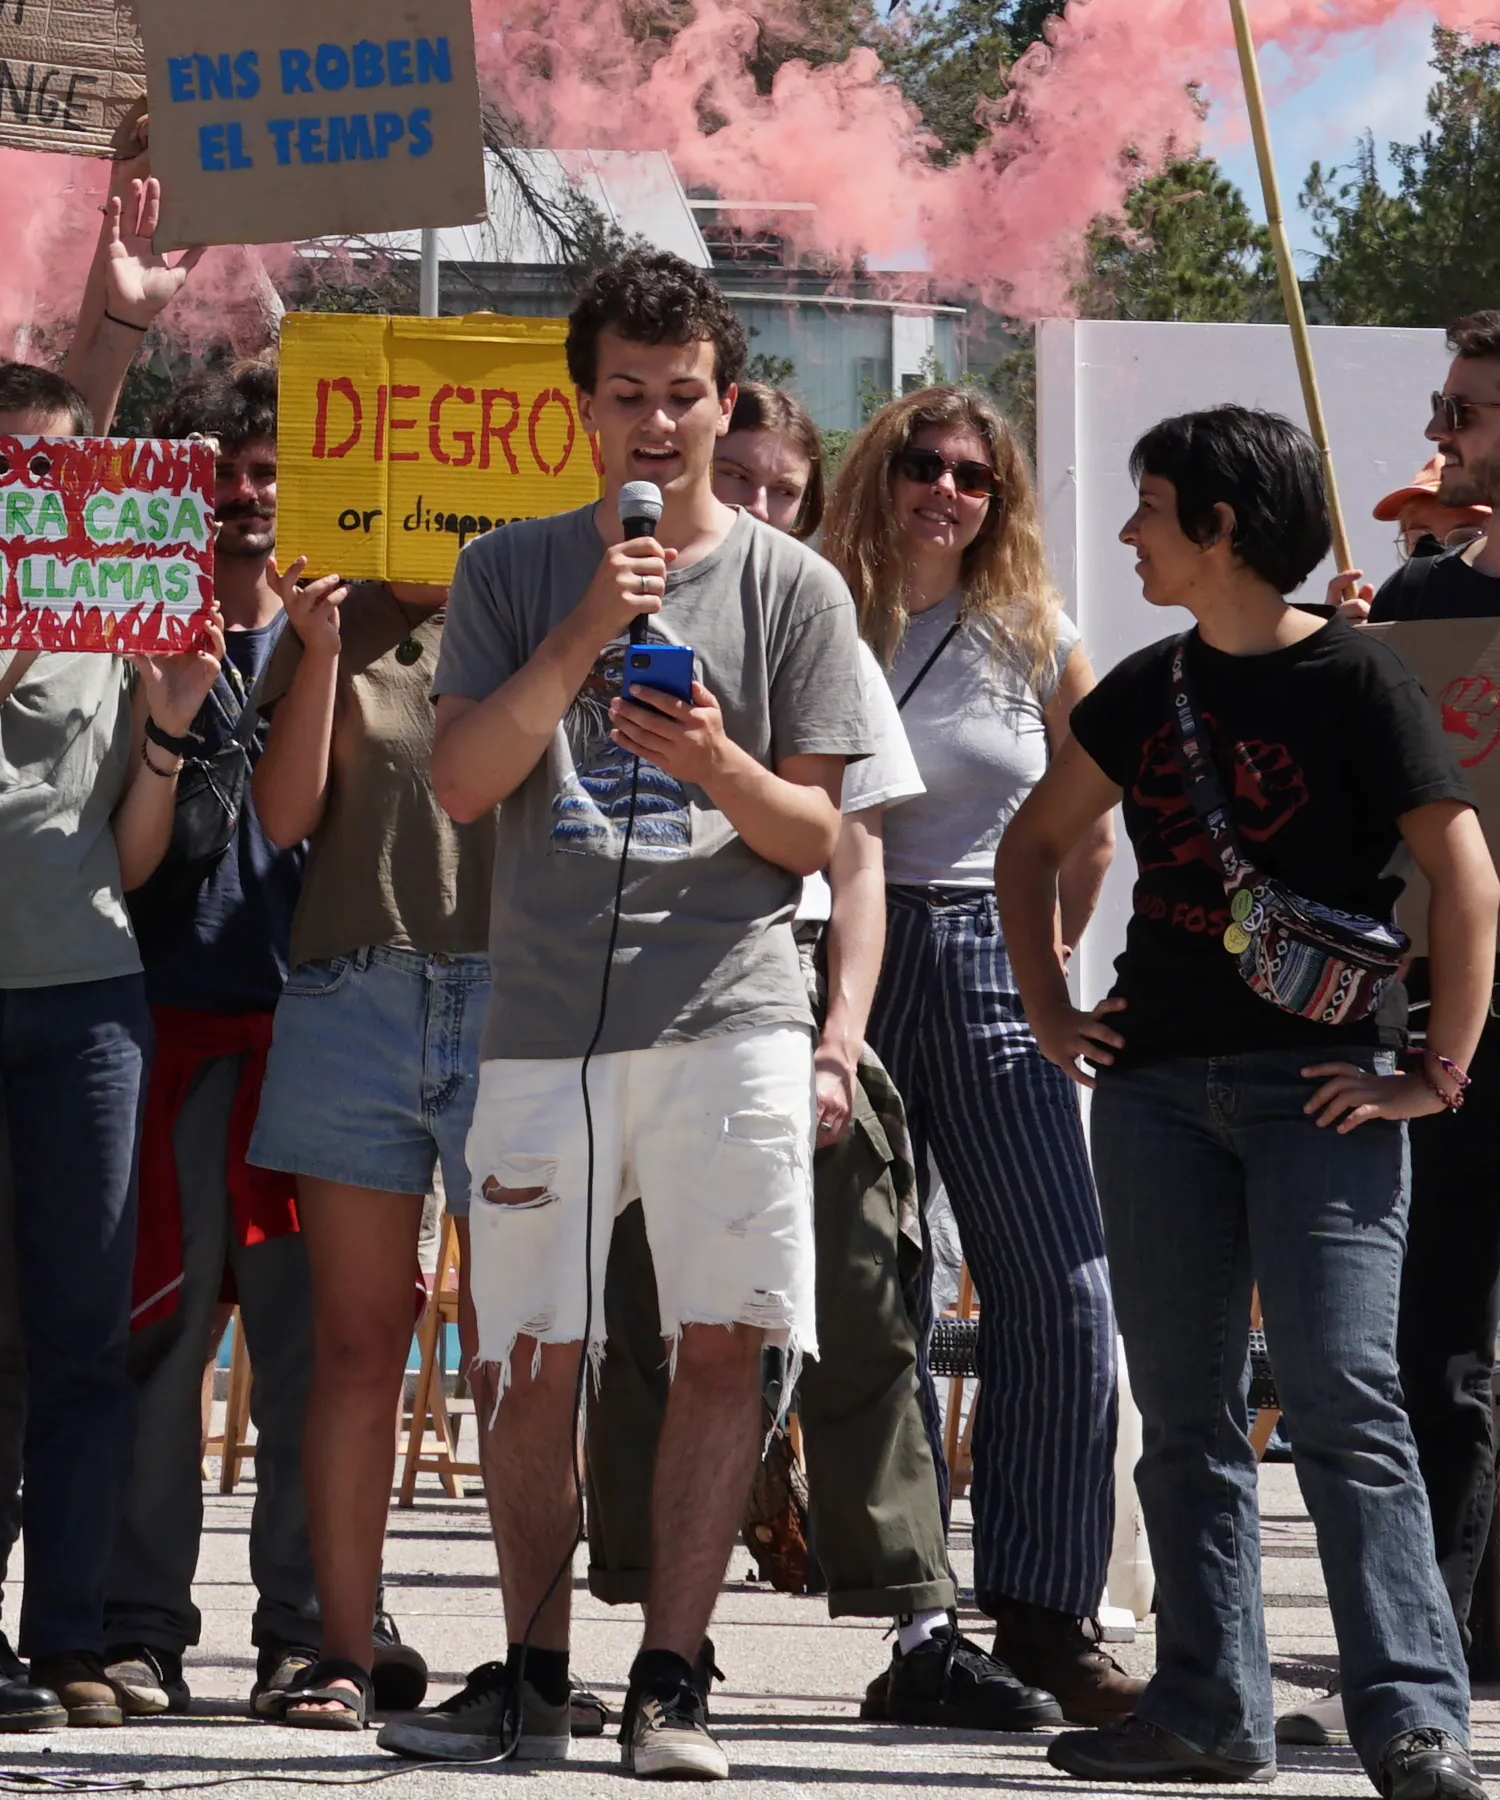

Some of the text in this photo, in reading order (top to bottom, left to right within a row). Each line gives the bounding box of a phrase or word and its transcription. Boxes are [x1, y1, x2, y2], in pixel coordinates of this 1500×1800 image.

[168, 36, 452, 103] ENS ROBEN
[199, 108, 434, 172] EL TEMPS
[311, 376, 605, 478] DEGRO
[83, 496, 205, 542] CASA
[337, 494, 538, 549] or disappe
[19, 559, 191, 602] LLAMAS
